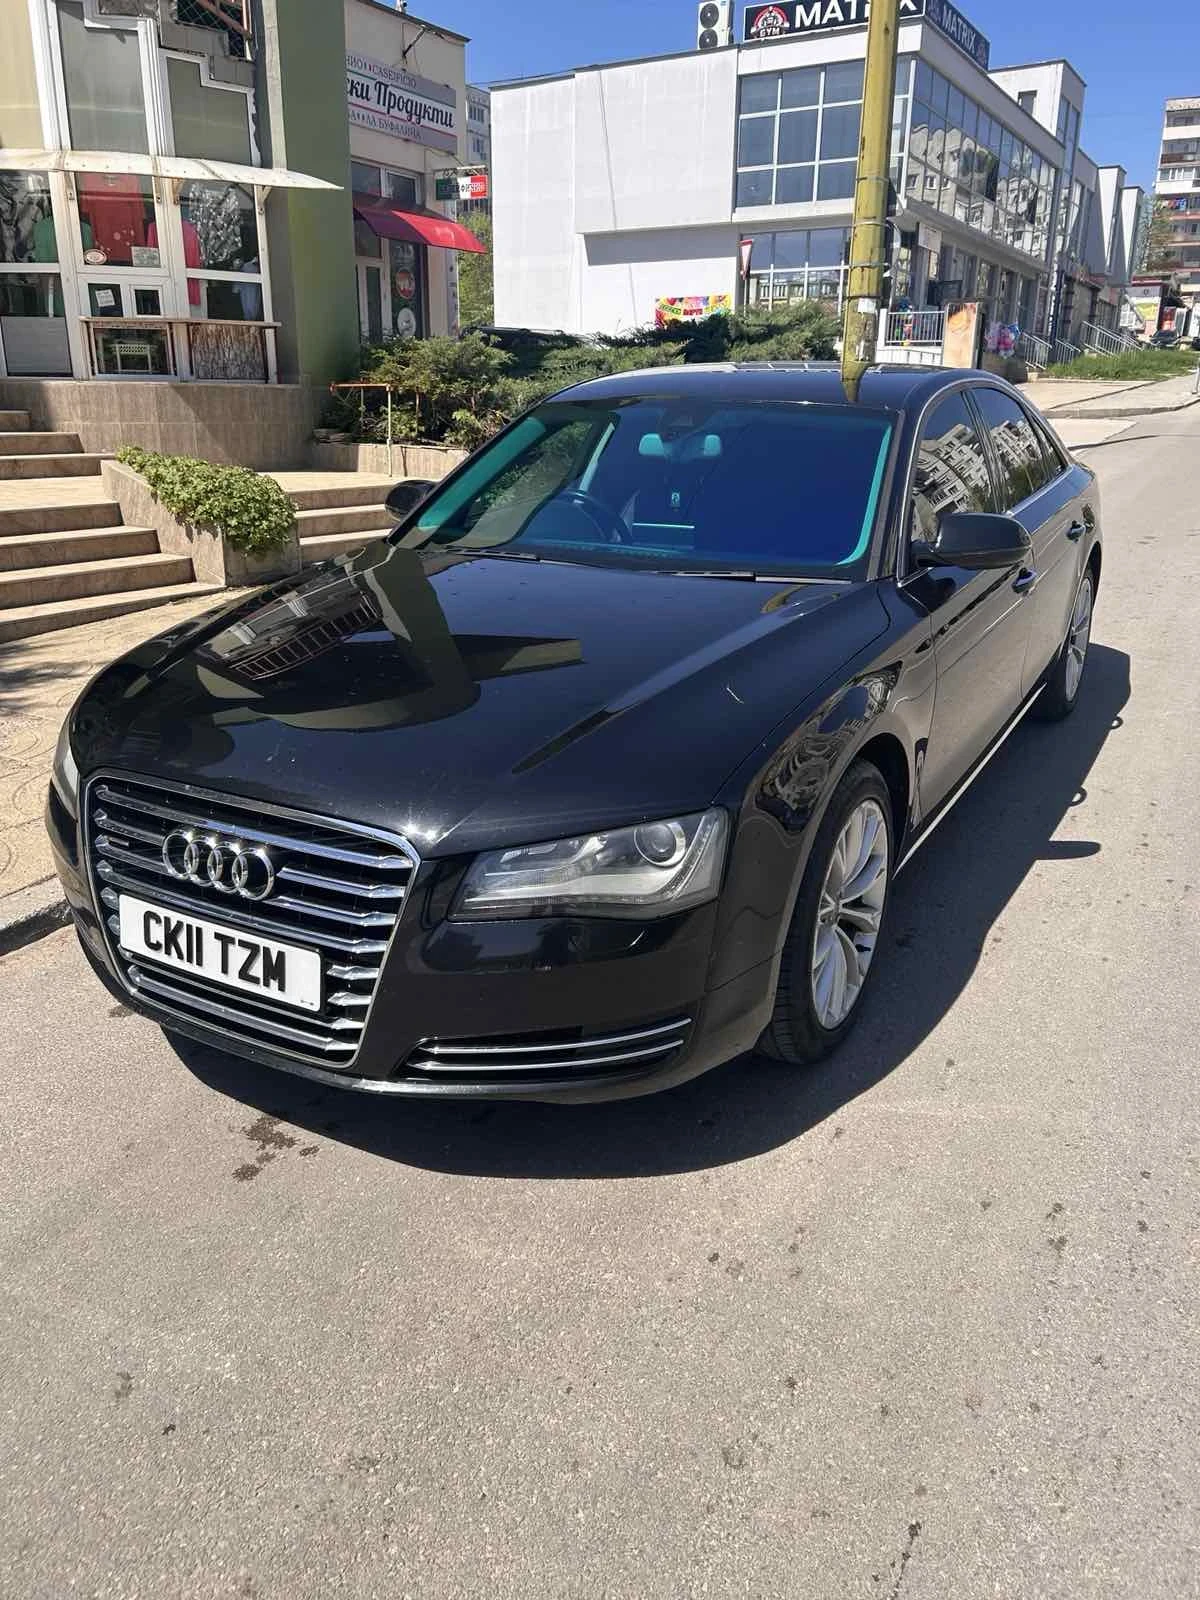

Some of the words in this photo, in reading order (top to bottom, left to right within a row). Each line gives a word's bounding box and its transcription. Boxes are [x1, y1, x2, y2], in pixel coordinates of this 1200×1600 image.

[759, 28, 780, 37] GYM
[943, 4, 976, 54] MATRIX
[374, 81, 454, 128] Продукти
[143, 910, 203, 967] CK11
[214, 931, 286, 992] TZM
